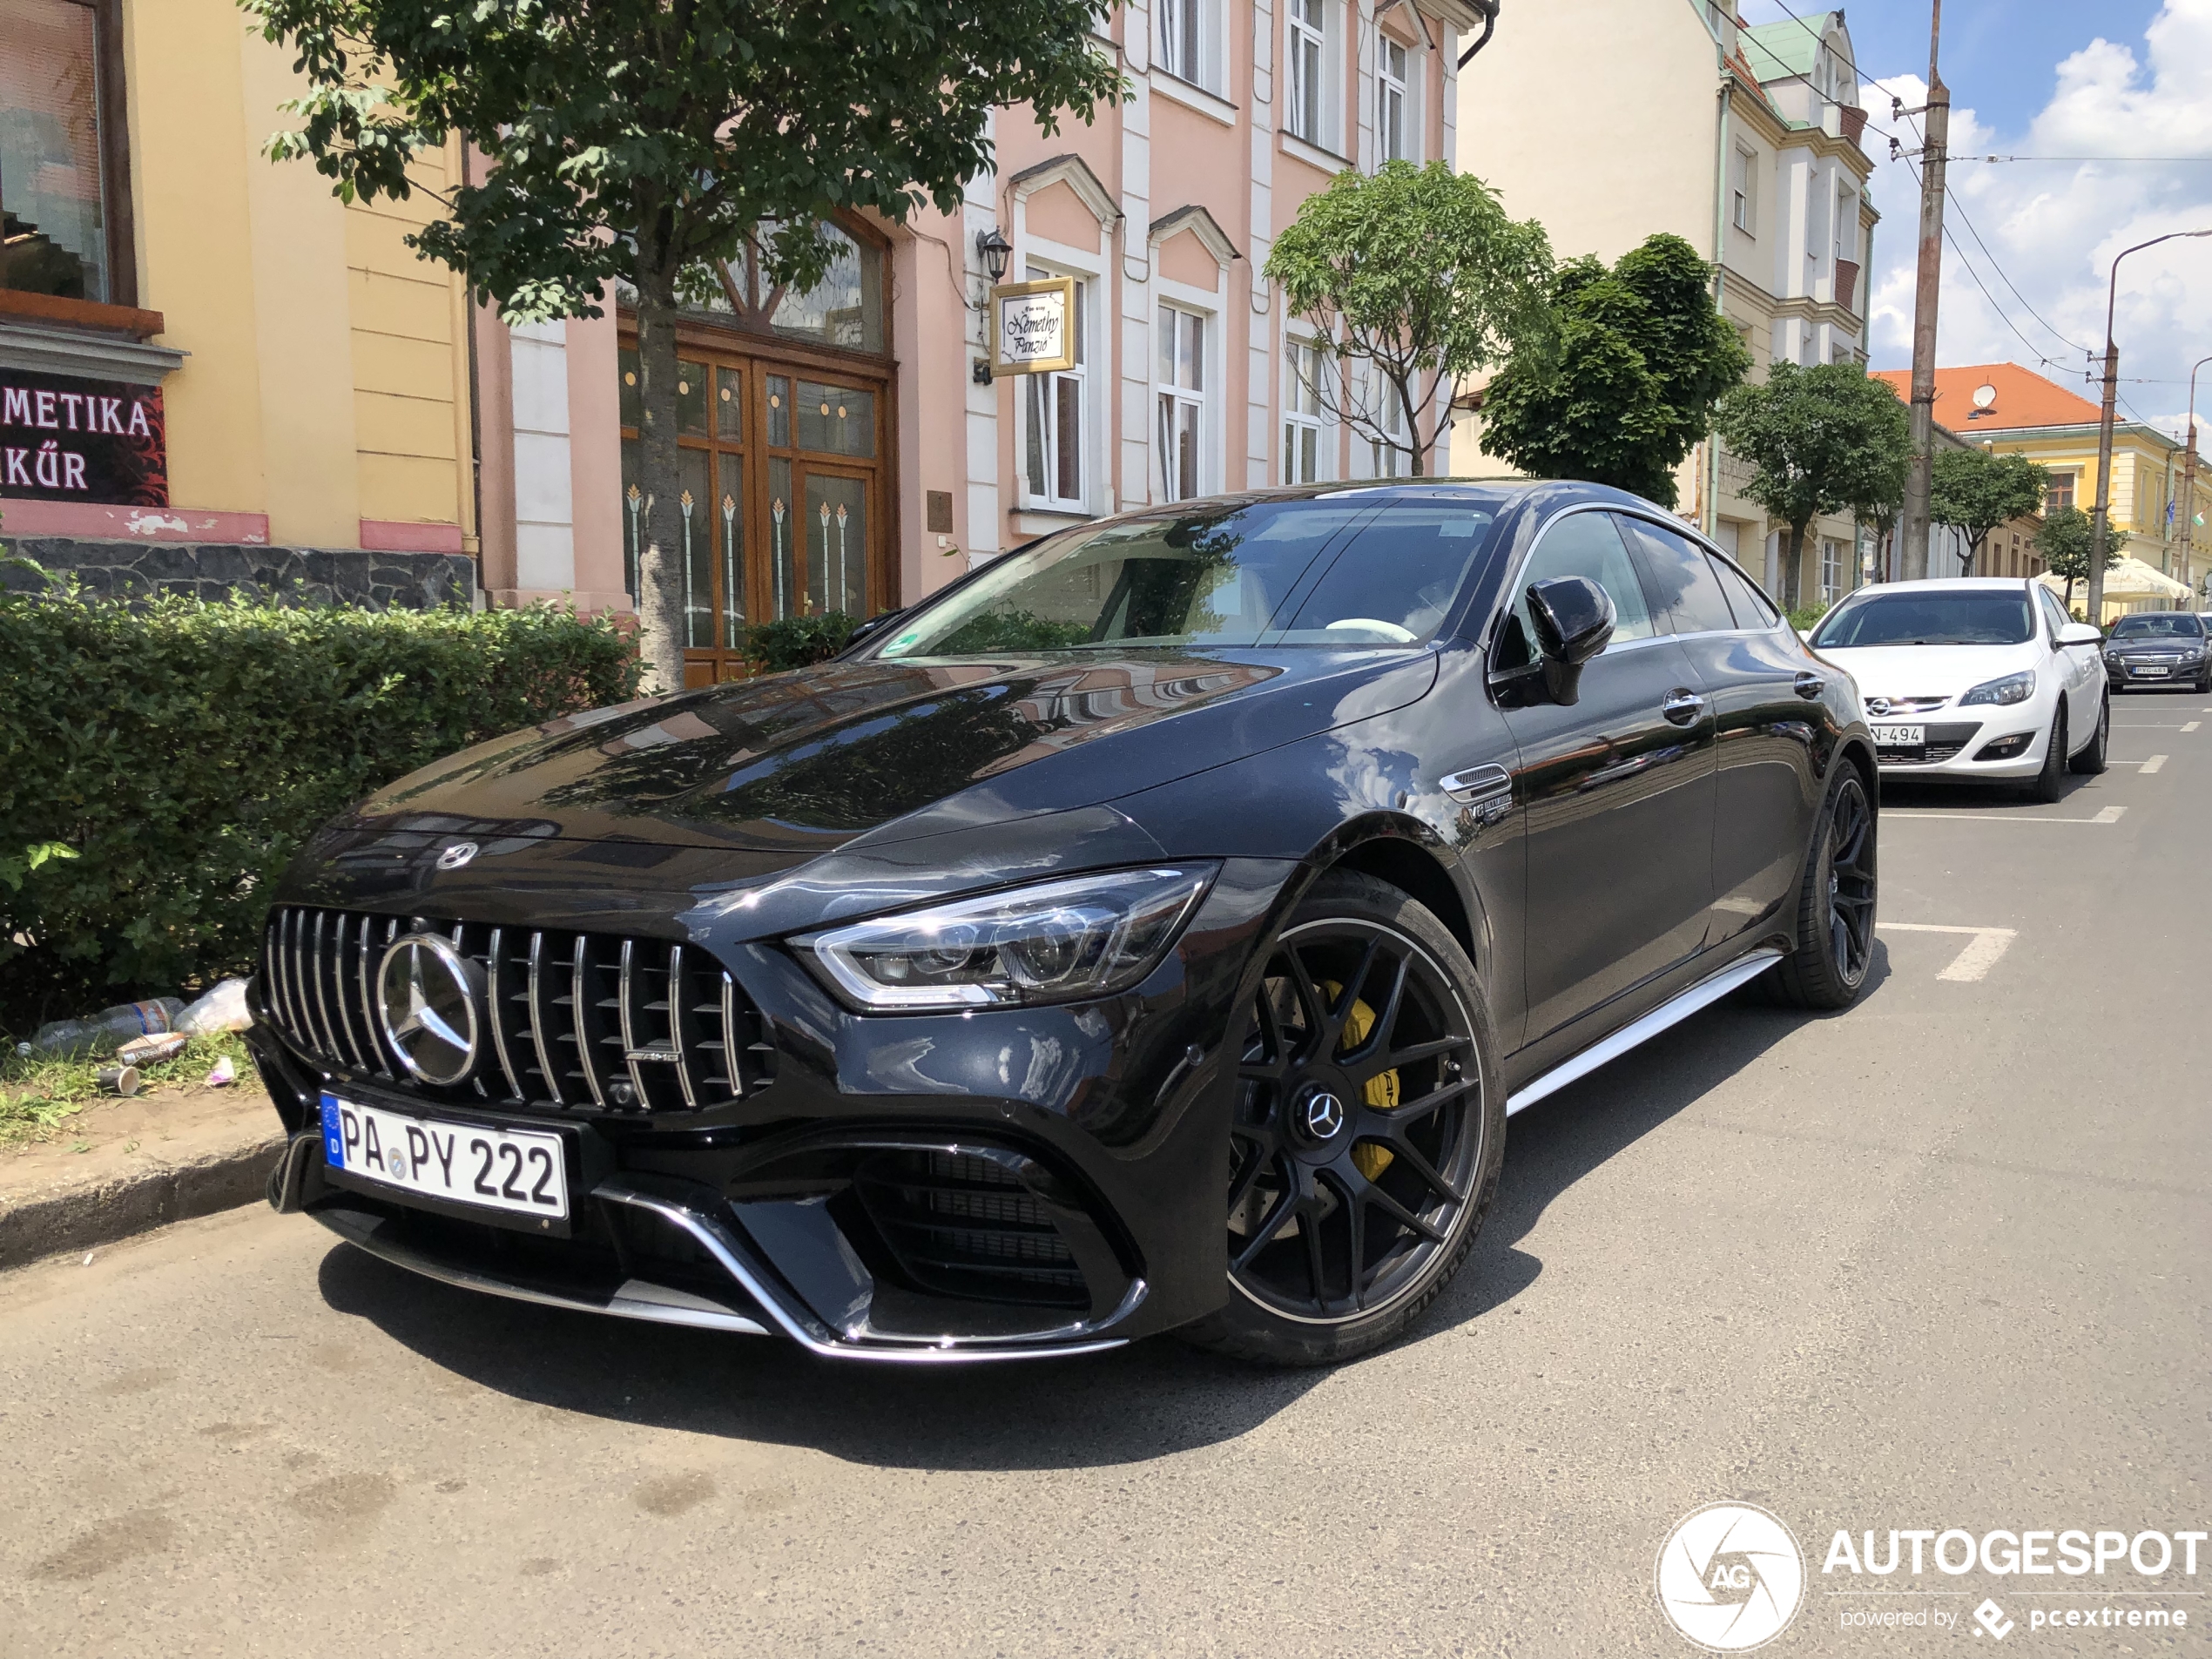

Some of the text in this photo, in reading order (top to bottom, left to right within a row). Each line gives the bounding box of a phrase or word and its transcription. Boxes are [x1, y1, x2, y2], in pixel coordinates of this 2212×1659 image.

[1014, 336, 1048, 354] Panzió
[3, 388, 151, 436] METIKA
[0, 441, 88, 489] KŰR
[331, 1137, 340, 1154] D
[341, 1108, 557, 1206] PA PY 222
[1410, 1213, 1483, 1320] MICHELIN
